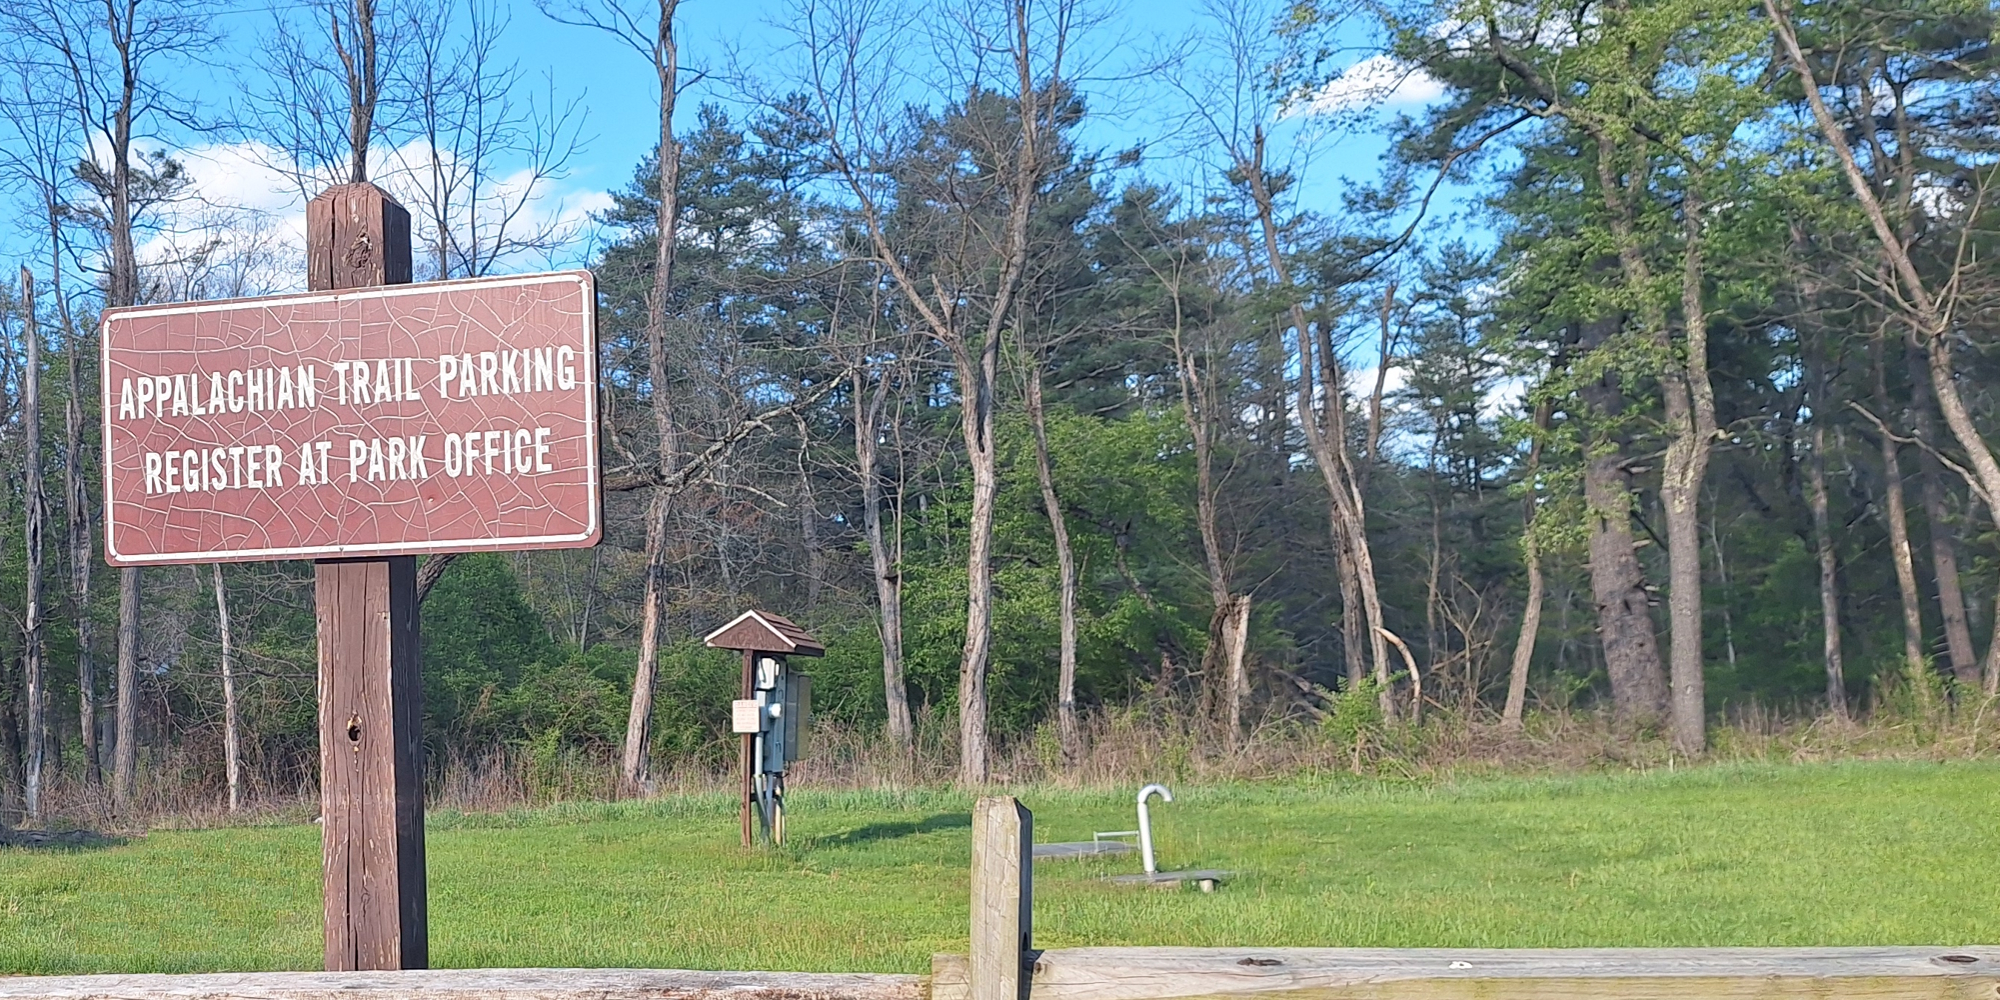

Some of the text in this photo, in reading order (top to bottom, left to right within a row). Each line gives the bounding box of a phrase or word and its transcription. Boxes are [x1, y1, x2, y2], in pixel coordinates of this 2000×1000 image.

[119, 345, 576, 421] APPALACHIAN TRAIL PARKING
[145, 427, 553, 494] REGISTER AT PARK OFFICE
